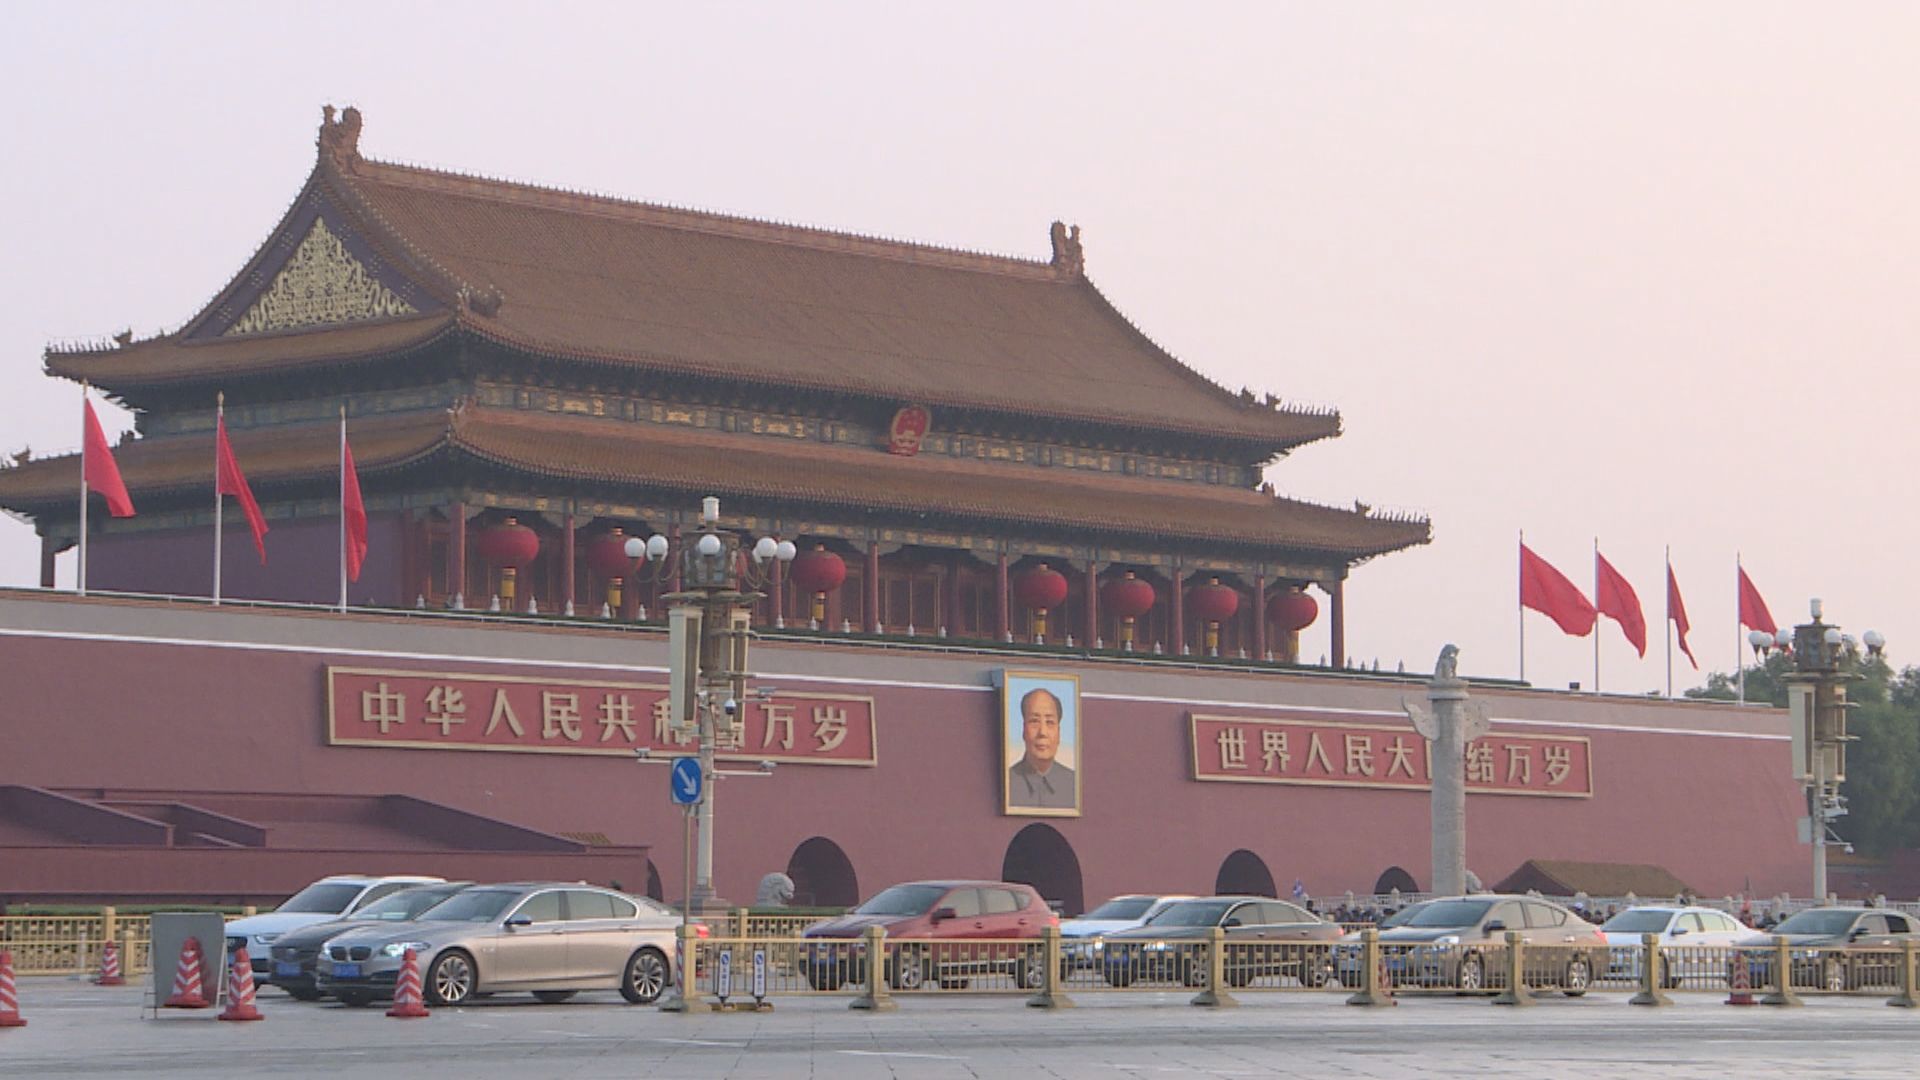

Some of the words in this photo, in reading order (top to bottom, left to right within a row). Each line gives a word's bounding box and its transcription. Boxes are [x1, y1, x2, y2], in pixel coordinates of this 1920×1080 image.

[362, 682, 849, 753] 中华人民共和万岁
[1217, 728, 1572, 784] 世界人民大结万岁
